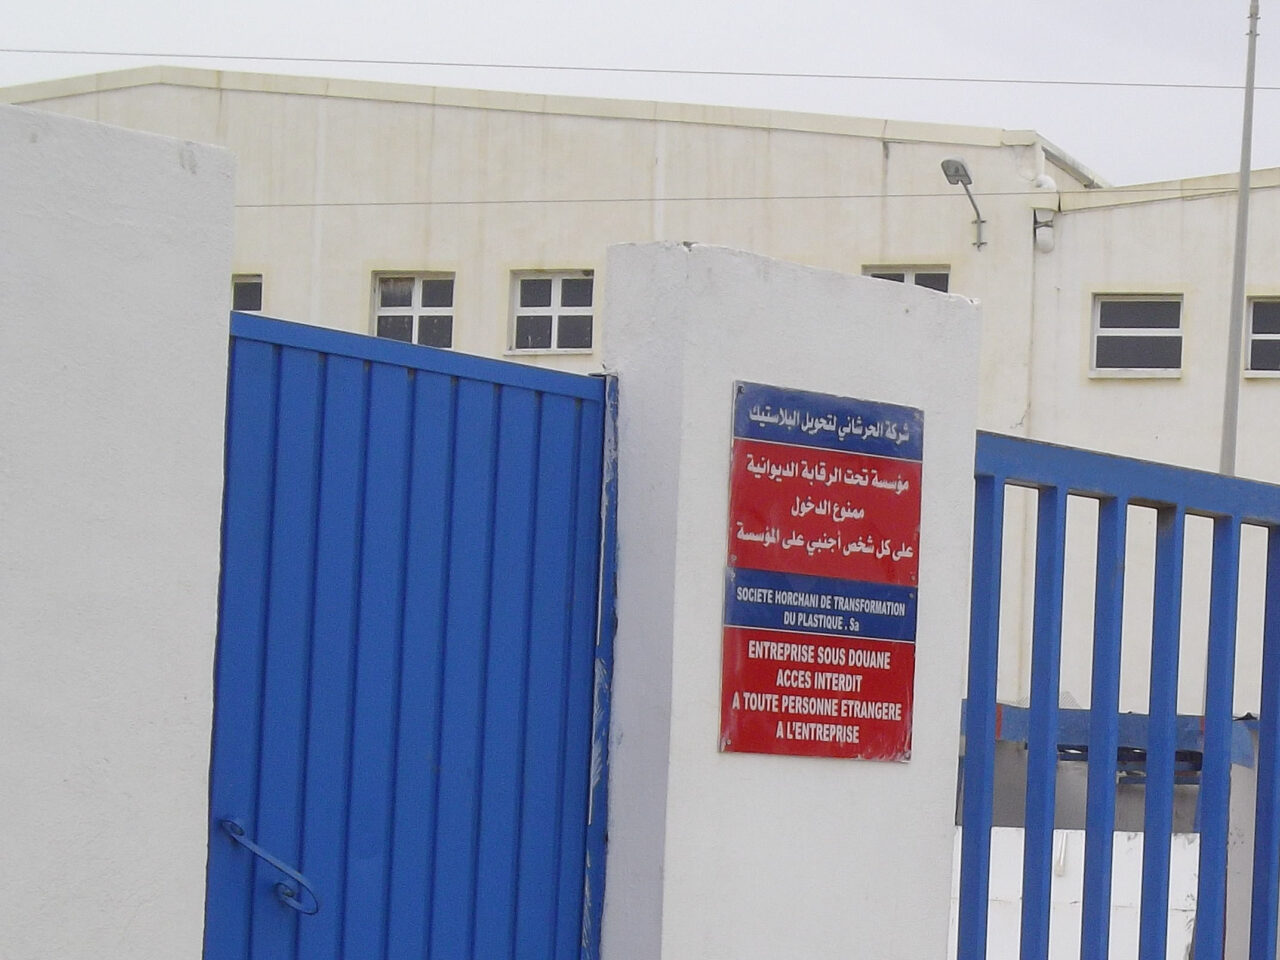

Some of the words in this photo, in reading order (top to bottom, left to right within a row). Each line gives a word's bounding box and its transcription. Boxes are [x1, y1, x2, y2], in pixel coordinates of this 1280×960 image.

[749, 405, 799, 429] البلاستيك
[801, 411, 837, 435] لتحويل
[838, 416, 883, 440] الحرشاني
[885, 420, 910, 445] شركة
[746, 454, 798, 480] الديوانية
[801, 461, 842, 486] الرقابة
[844, 468, 869, 486] تحت
[871, 467, 909, 494] مؤسسة
[791, 496, 831, 516] الدخول
[833, 502, 865, 521] ممنوع
[736, 521, 779, 547] المؤسسة
[782, 530, 804, 550] على
[807, 530, 841, 556] أجنبي
[843, 534, 874, 556] شخص
[876, 539, 890, 559] كل
[892, 543, 914, 560] على
[736, 587, 773, 603] SOCIETE
[775, 591, 819, 607] HORCHANI
[820, 596, 832, 610] DE
[833, 596, 905, 616] TRANSFORMATION
[784, 611, 796, 625] DU
[797, 612, 843, 630] PLASTIQUE
[849, 618, 860, 632] Sa
[748, 640, 815, 663] ENTREPRISE
[817, 646, 845, 666] SOUS
[848, 649, 891, 670] DOUANE
[776, 669, 811, 688] ACCES
[814, 673, 862, 692] INTERDIT
[732, 692, 740, 710] A
[743, 692, 779, 712] TOUTE
[782, 695, 838, 717] PERSONNE
[841, 700, 902, 720] ETRANGERE
[776, 721, 784, 739] A
[787, 721, 860, 744] L'ENTREPRISE
